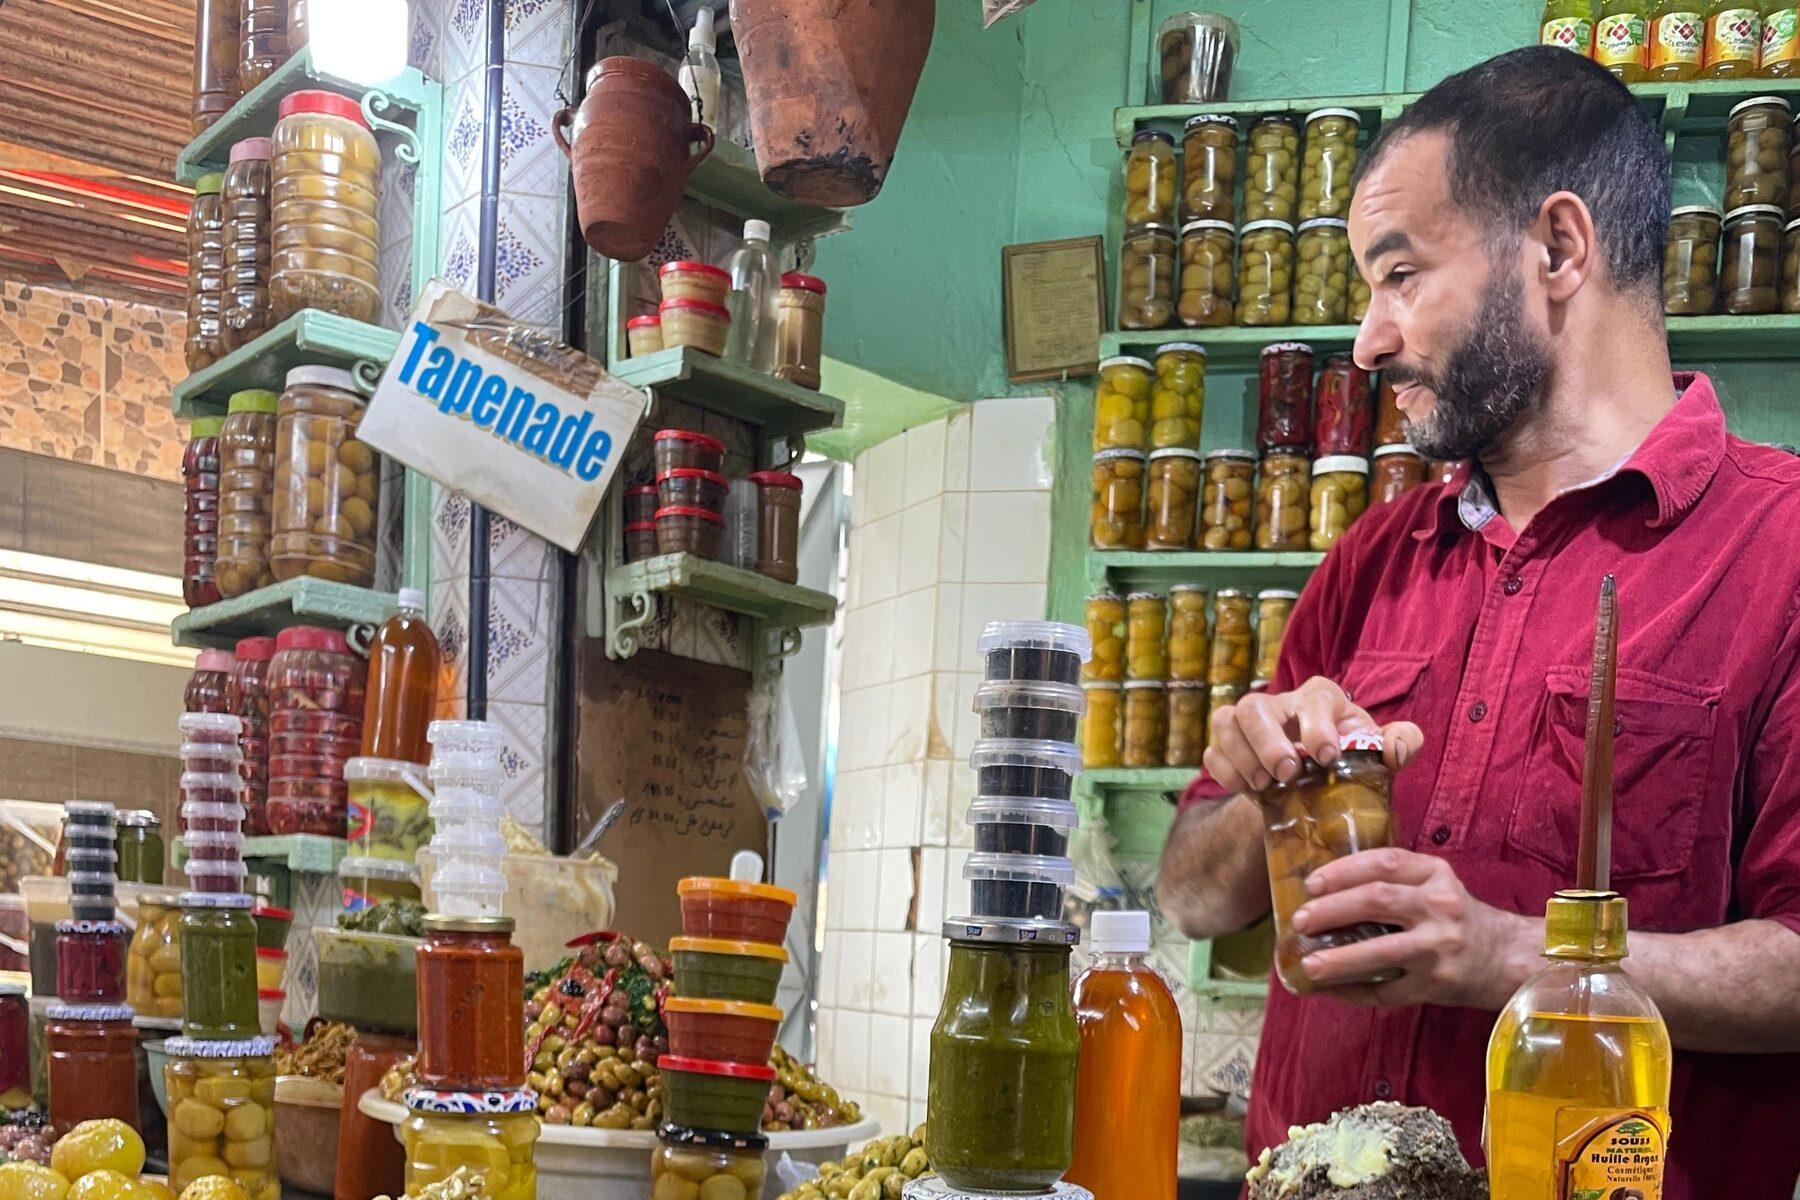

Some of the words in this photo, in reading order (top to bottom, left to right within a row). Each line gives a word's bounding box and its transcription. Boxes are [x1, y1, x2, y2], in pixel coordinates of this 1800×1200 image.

[398, 320, 612, 482] Tapenade
[1611, 1137, 1650, 1145] SOUSS
[1591, 1153, 1630, 1164] Huille
